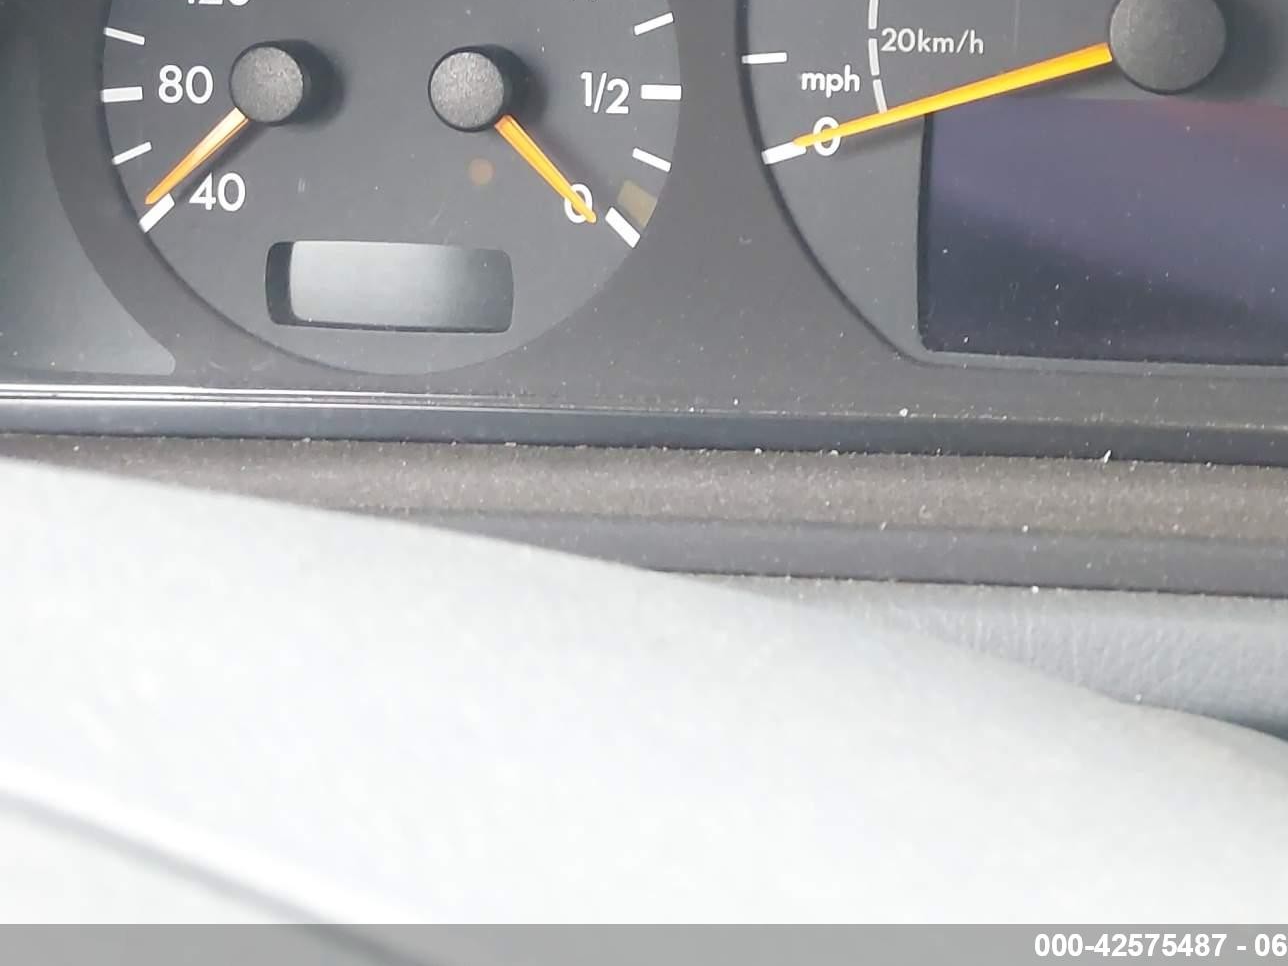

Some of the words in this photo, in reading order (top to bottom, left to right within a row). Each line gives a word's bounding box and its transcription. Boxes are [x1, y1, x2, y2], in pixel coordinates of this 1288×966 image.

[158, 66, 214, 105] 80
[580, 72, 630, 115] 1/2
[800, 65, 860, 98] mph
[813, 116, 841, 157] 0
[189, 174, 246, 212] 40
[564, 183, 593, 224] 0
